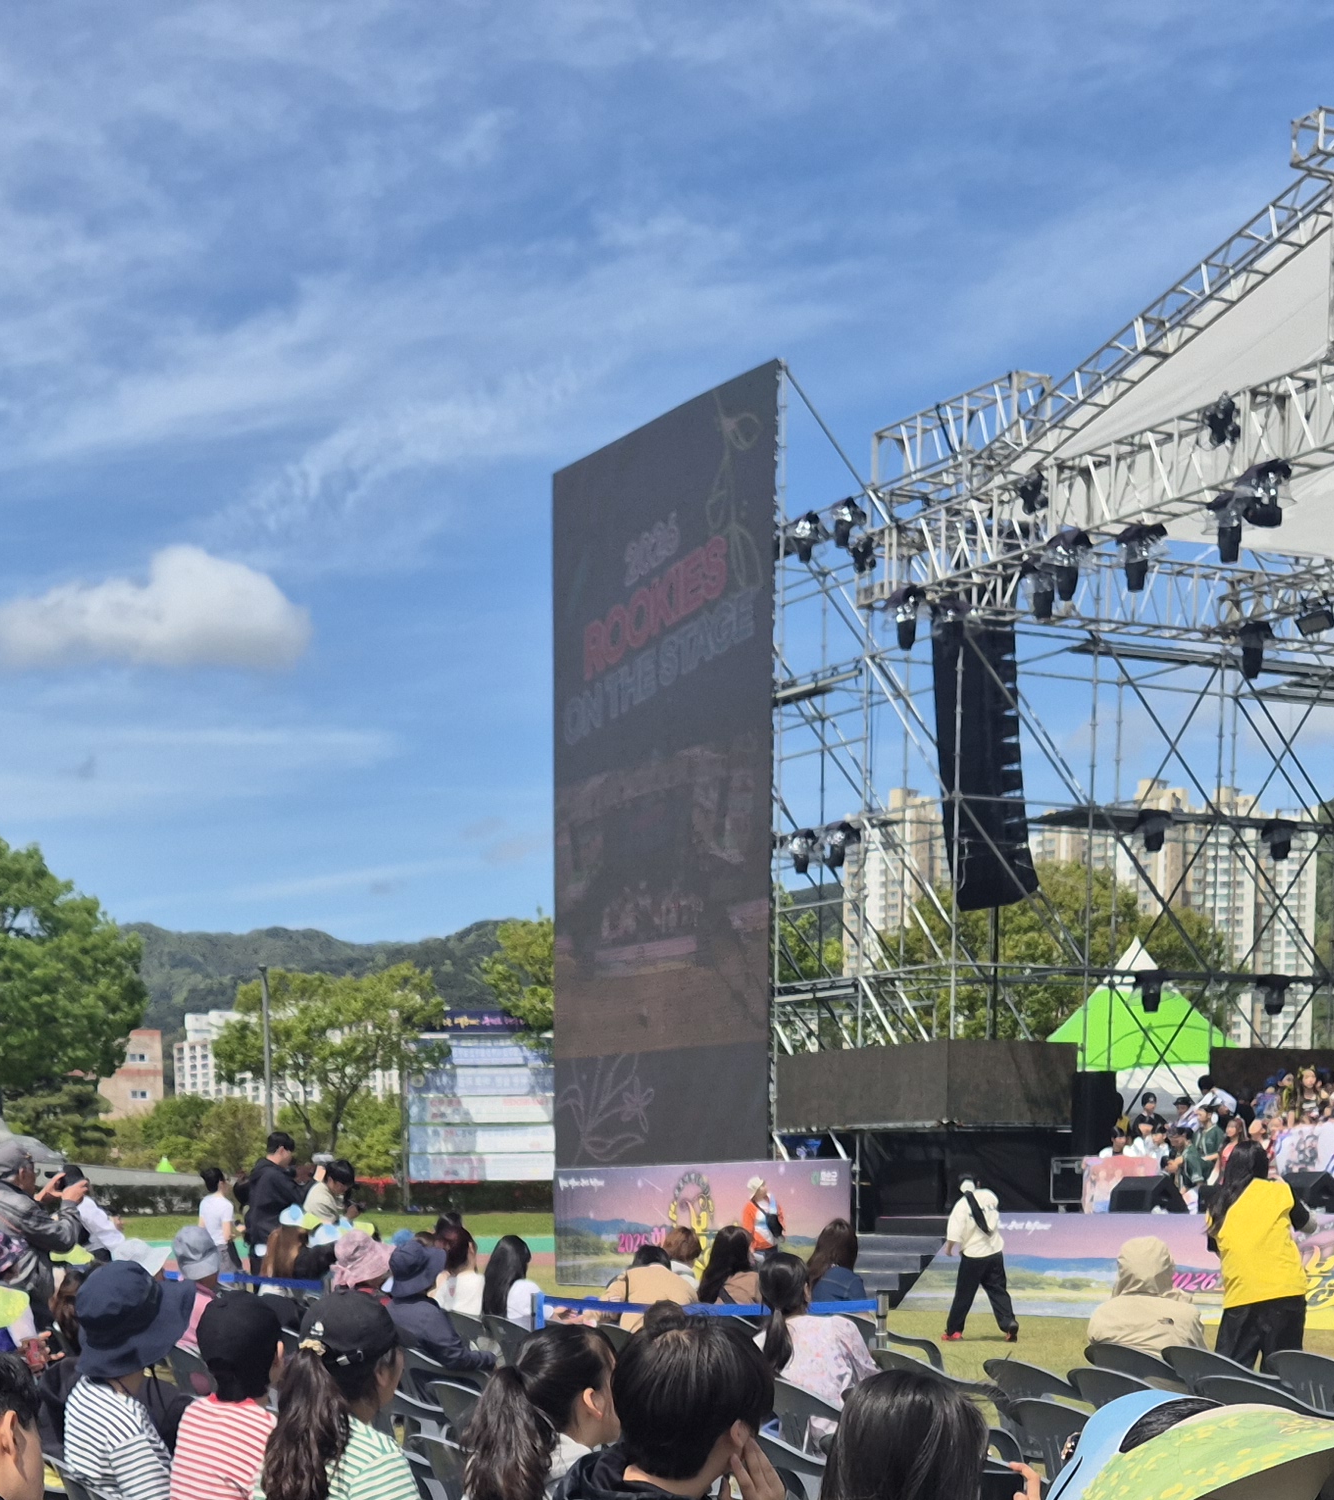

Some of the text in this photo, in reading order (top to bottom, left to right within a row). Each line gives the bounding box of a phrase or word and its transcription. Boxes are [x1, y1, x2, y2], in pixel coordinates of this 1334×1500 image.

[564, 588, 758, 745] ON THE STAGE
[583, 534, 728, 682] ROOKIES
